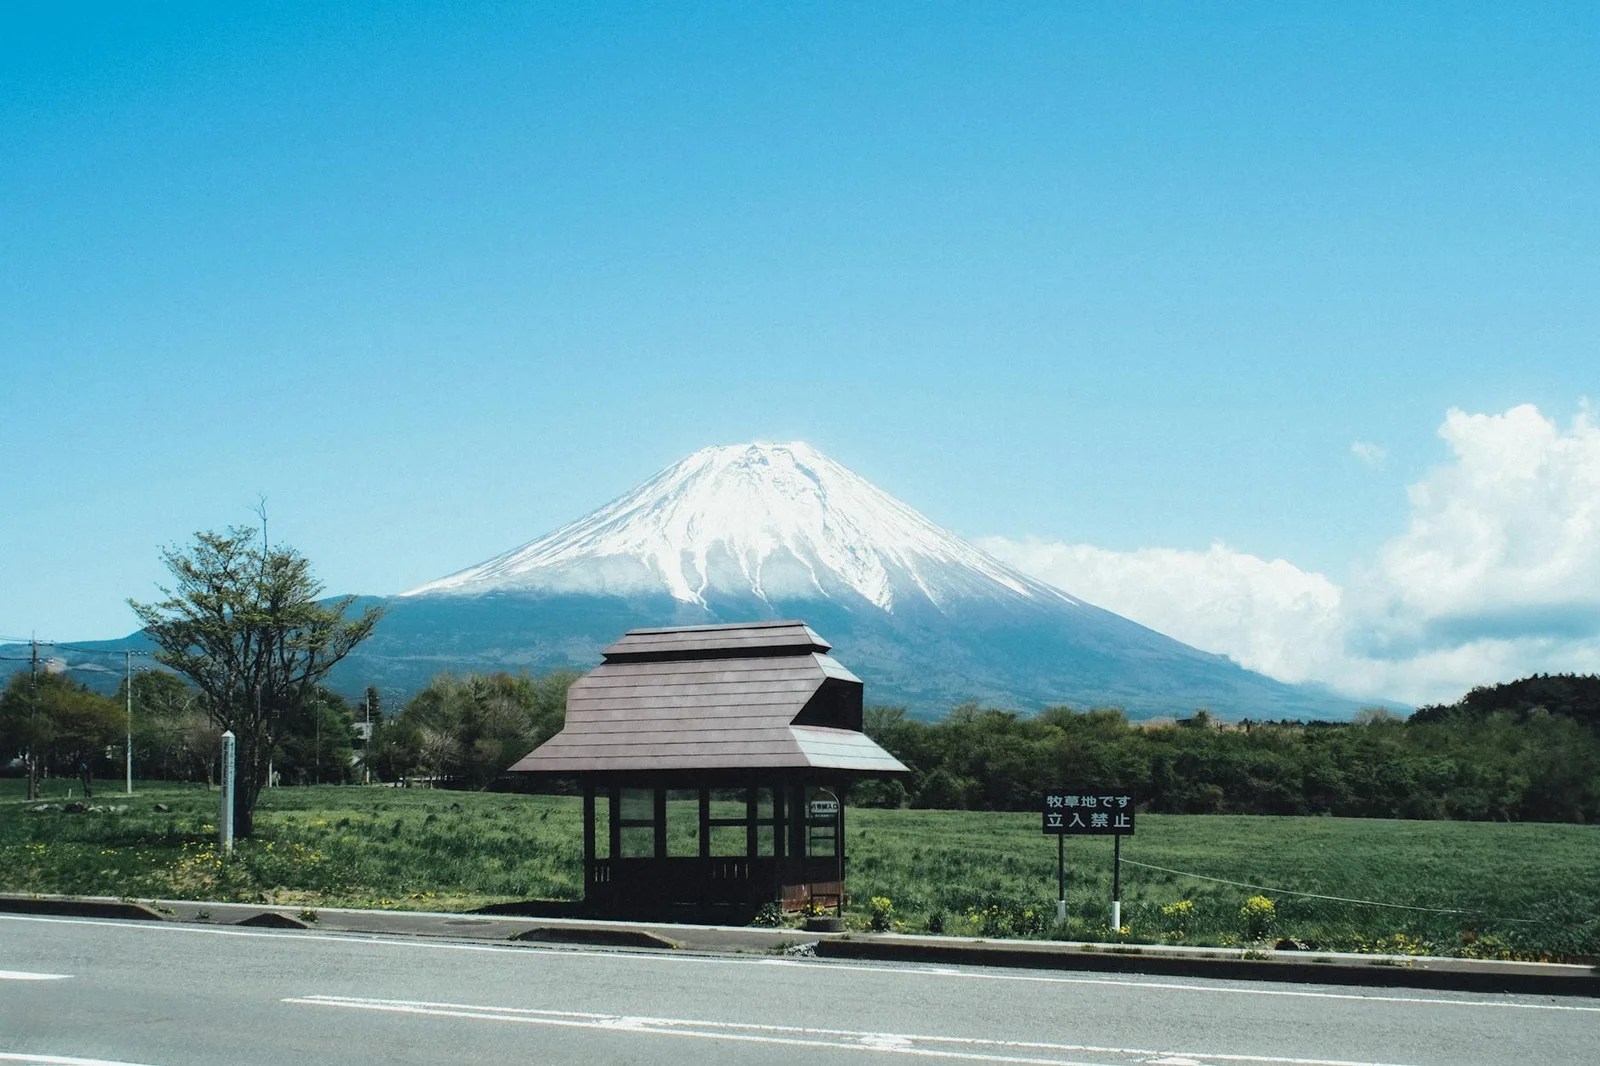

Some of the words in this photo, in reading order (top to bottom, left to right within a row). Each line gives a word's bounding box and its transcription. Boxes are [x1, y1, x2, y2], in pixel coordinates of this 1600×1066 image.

[1046, 795, 1131, 808] 牧草地です
[1046, 812, 1131, 827] 立入禁止
